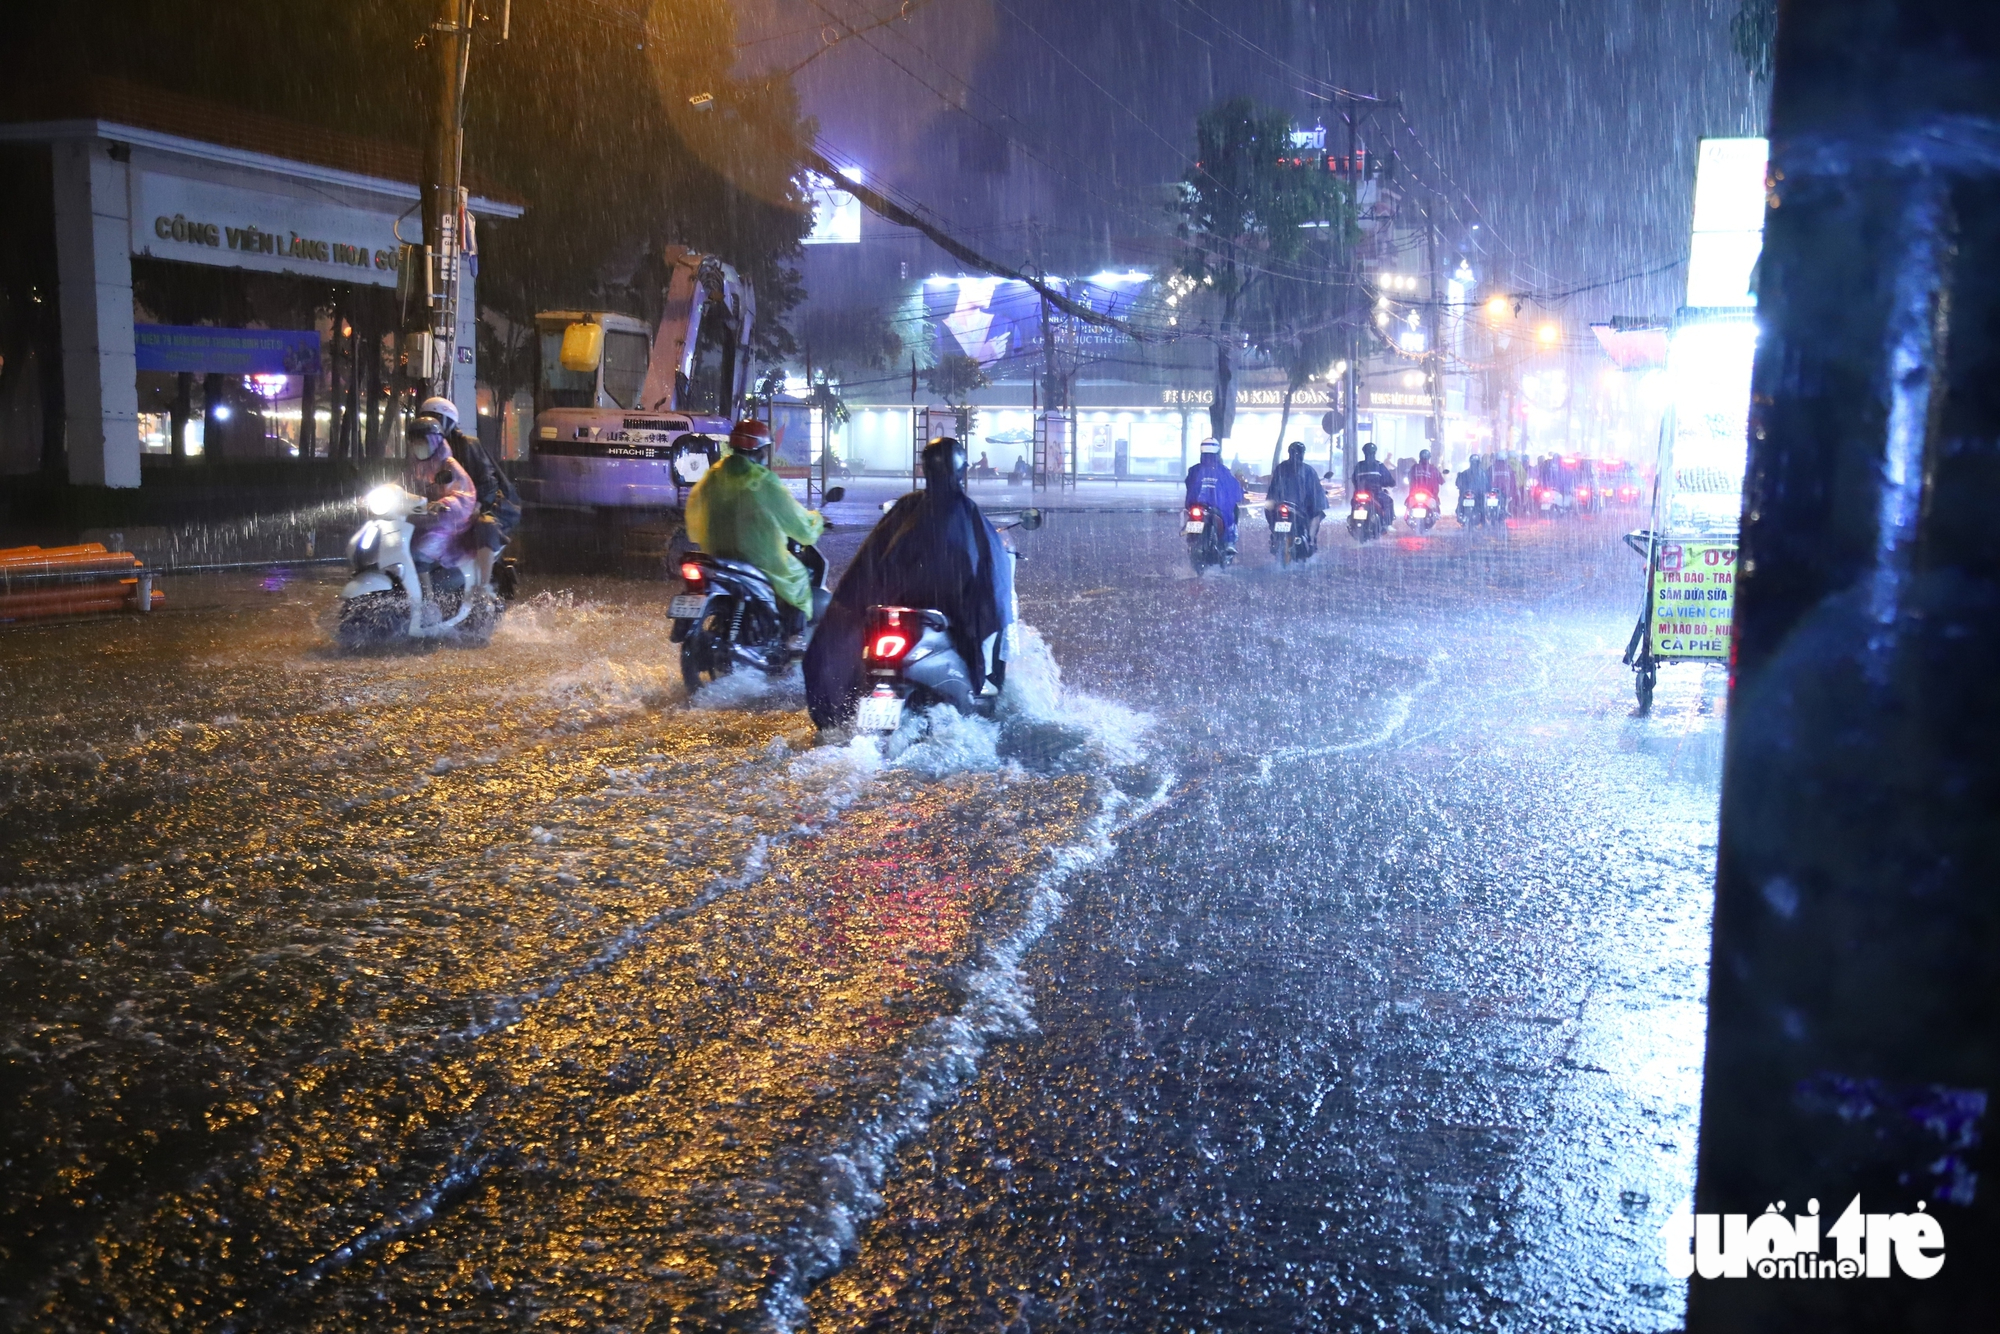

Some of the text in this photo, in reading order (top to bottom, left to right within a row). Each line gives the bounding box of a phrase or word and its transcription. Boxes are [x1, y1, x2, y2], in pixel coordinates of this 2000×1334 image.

[155, 213, 219, 247] CÔNG
[225, 225, 273, 254] VIÊN
[277, 231, 329, 263] LÀNG
[333, 243, 370, 267] HOA
[608, 447, 645, 456] HITACHI
[1712, 571, 1732, 584] TRÀ
[1660, 587, 1682, 600] SÂM
[1707, 587, 1727, 601] SỮA
[1677, 604, 1706, 618] VIÊN
[1709, 608, 1734, 619] CHI
[1659, 621, 1671, 634] MÌ
[1673, 621, 1692, 635] XÀO
[1694, 622, 1707, 635] BÒ
[1661, 637, 1684, 651] CÀ
[1689, 638, 1722, 651] PHÊ
